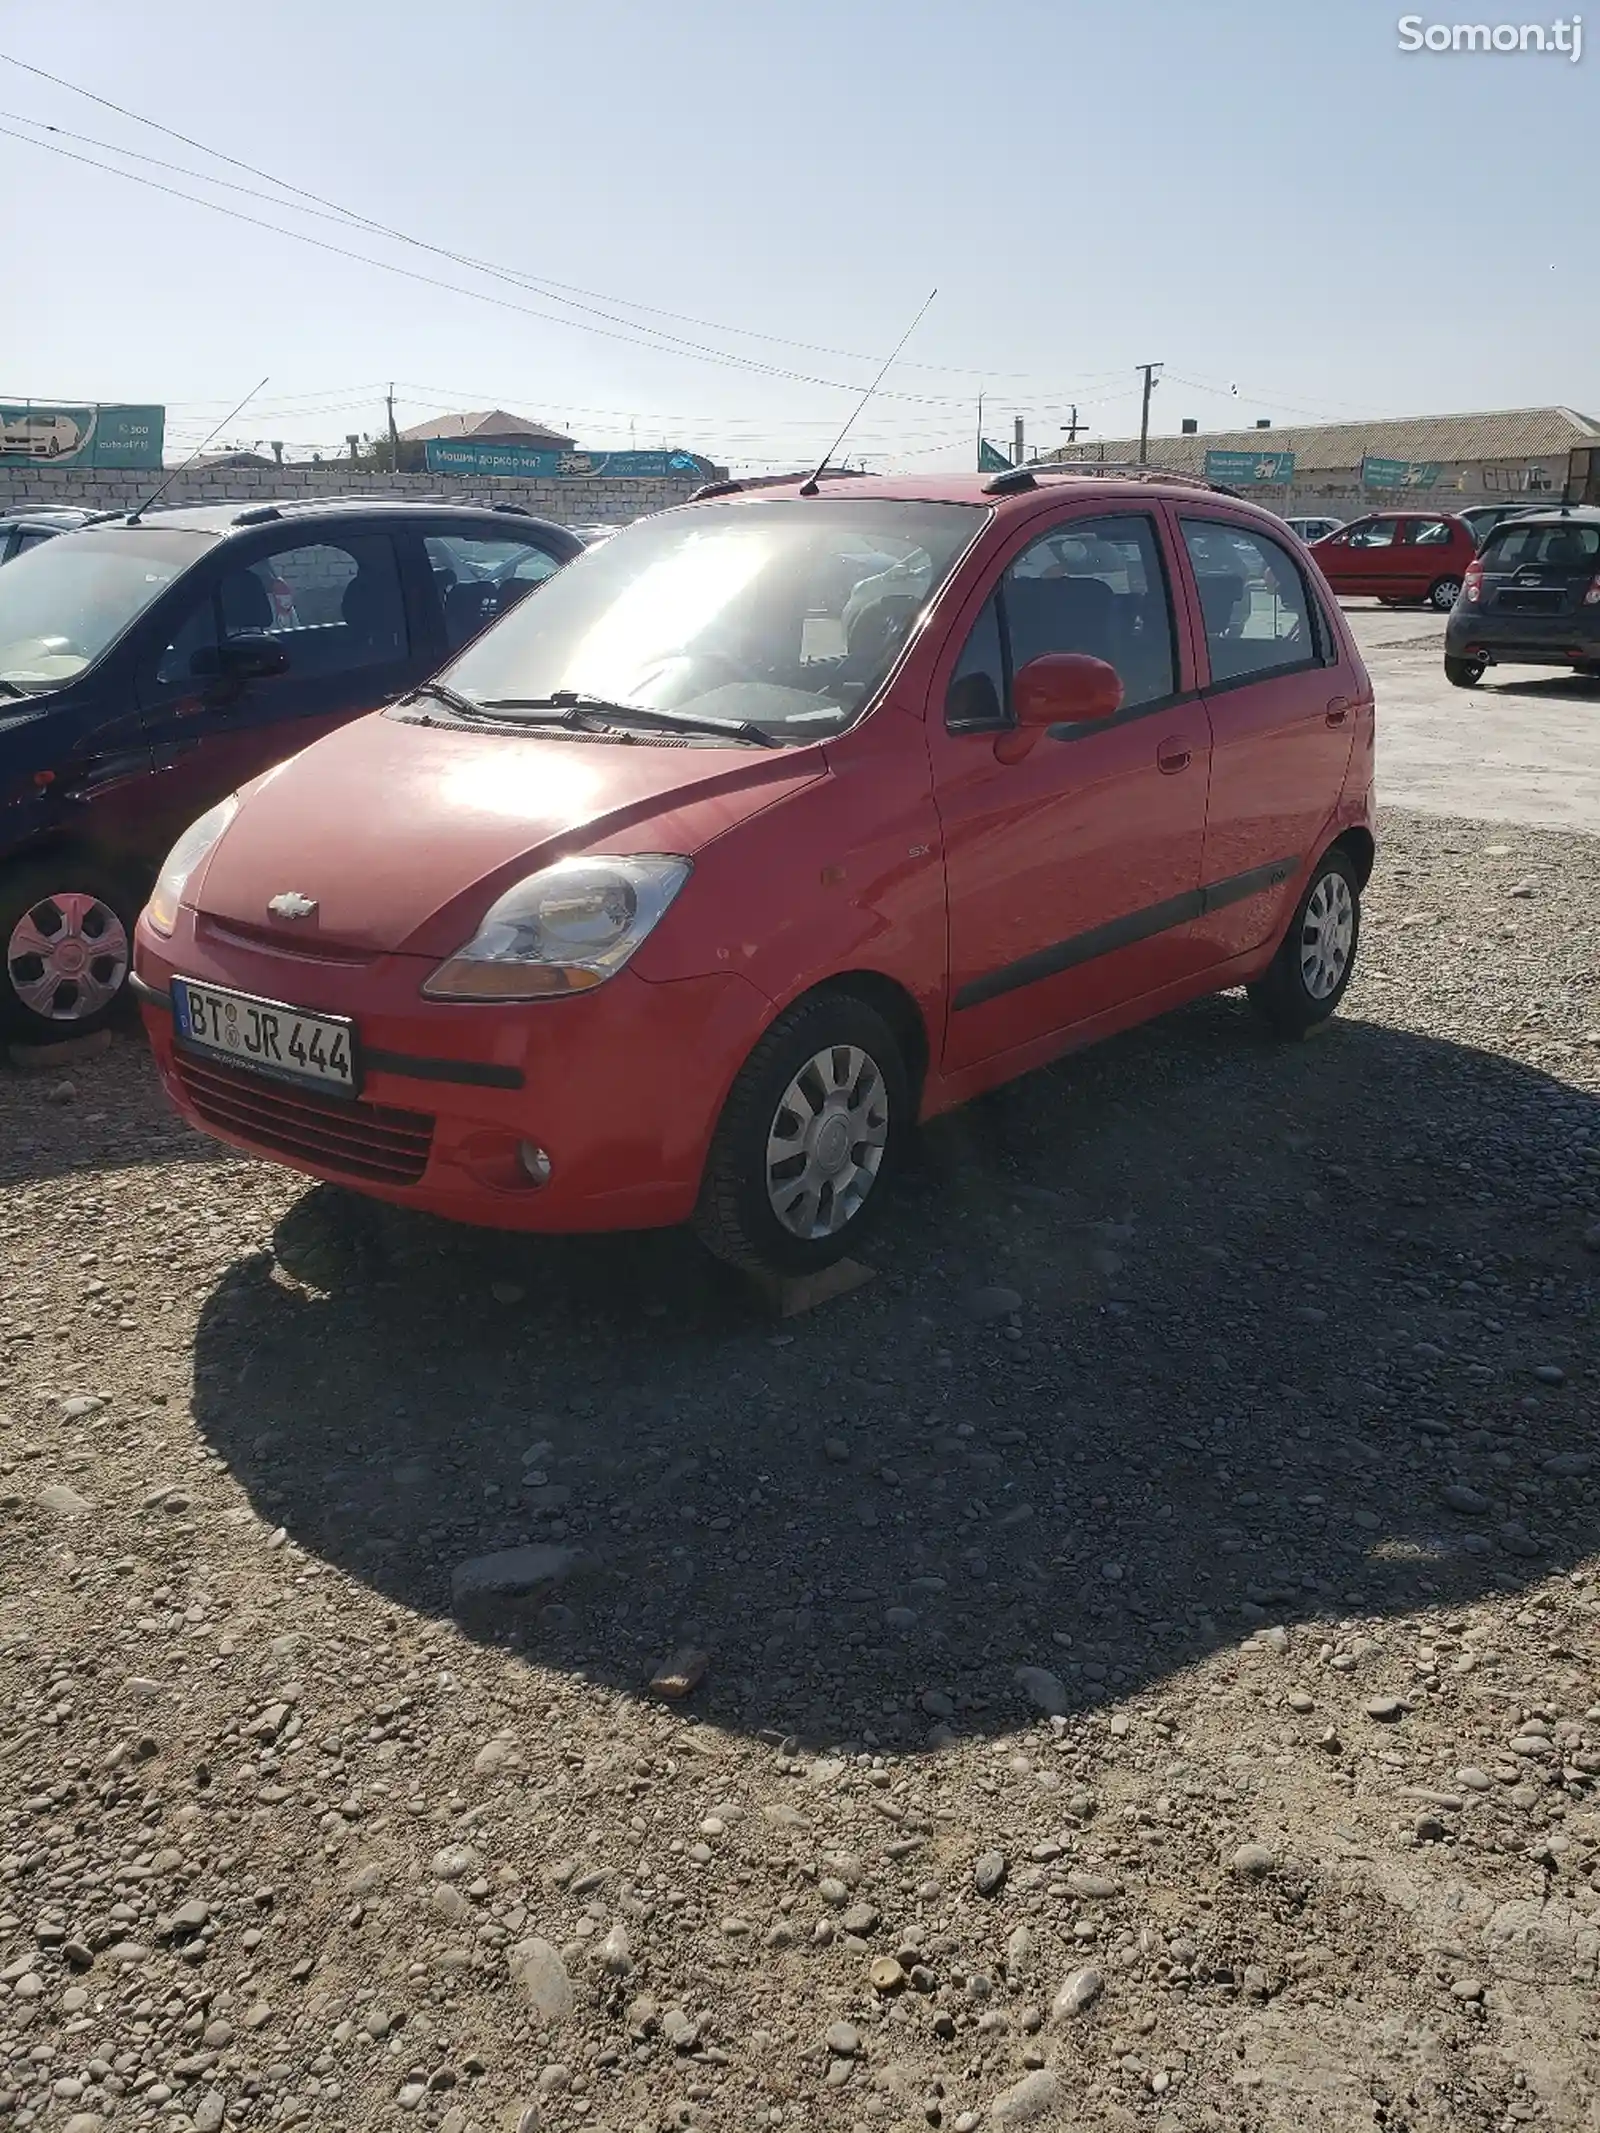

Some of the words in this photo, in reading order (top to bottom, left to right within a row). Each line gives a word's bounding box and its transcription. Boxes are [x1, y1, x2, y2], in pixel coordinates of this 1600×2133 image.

[909, 843, 930, 858] SX
[189, 991, 222, 1042] BT
[244, 1008, 282, 1061] JR
[288, 1022, 349, 1079] 444
